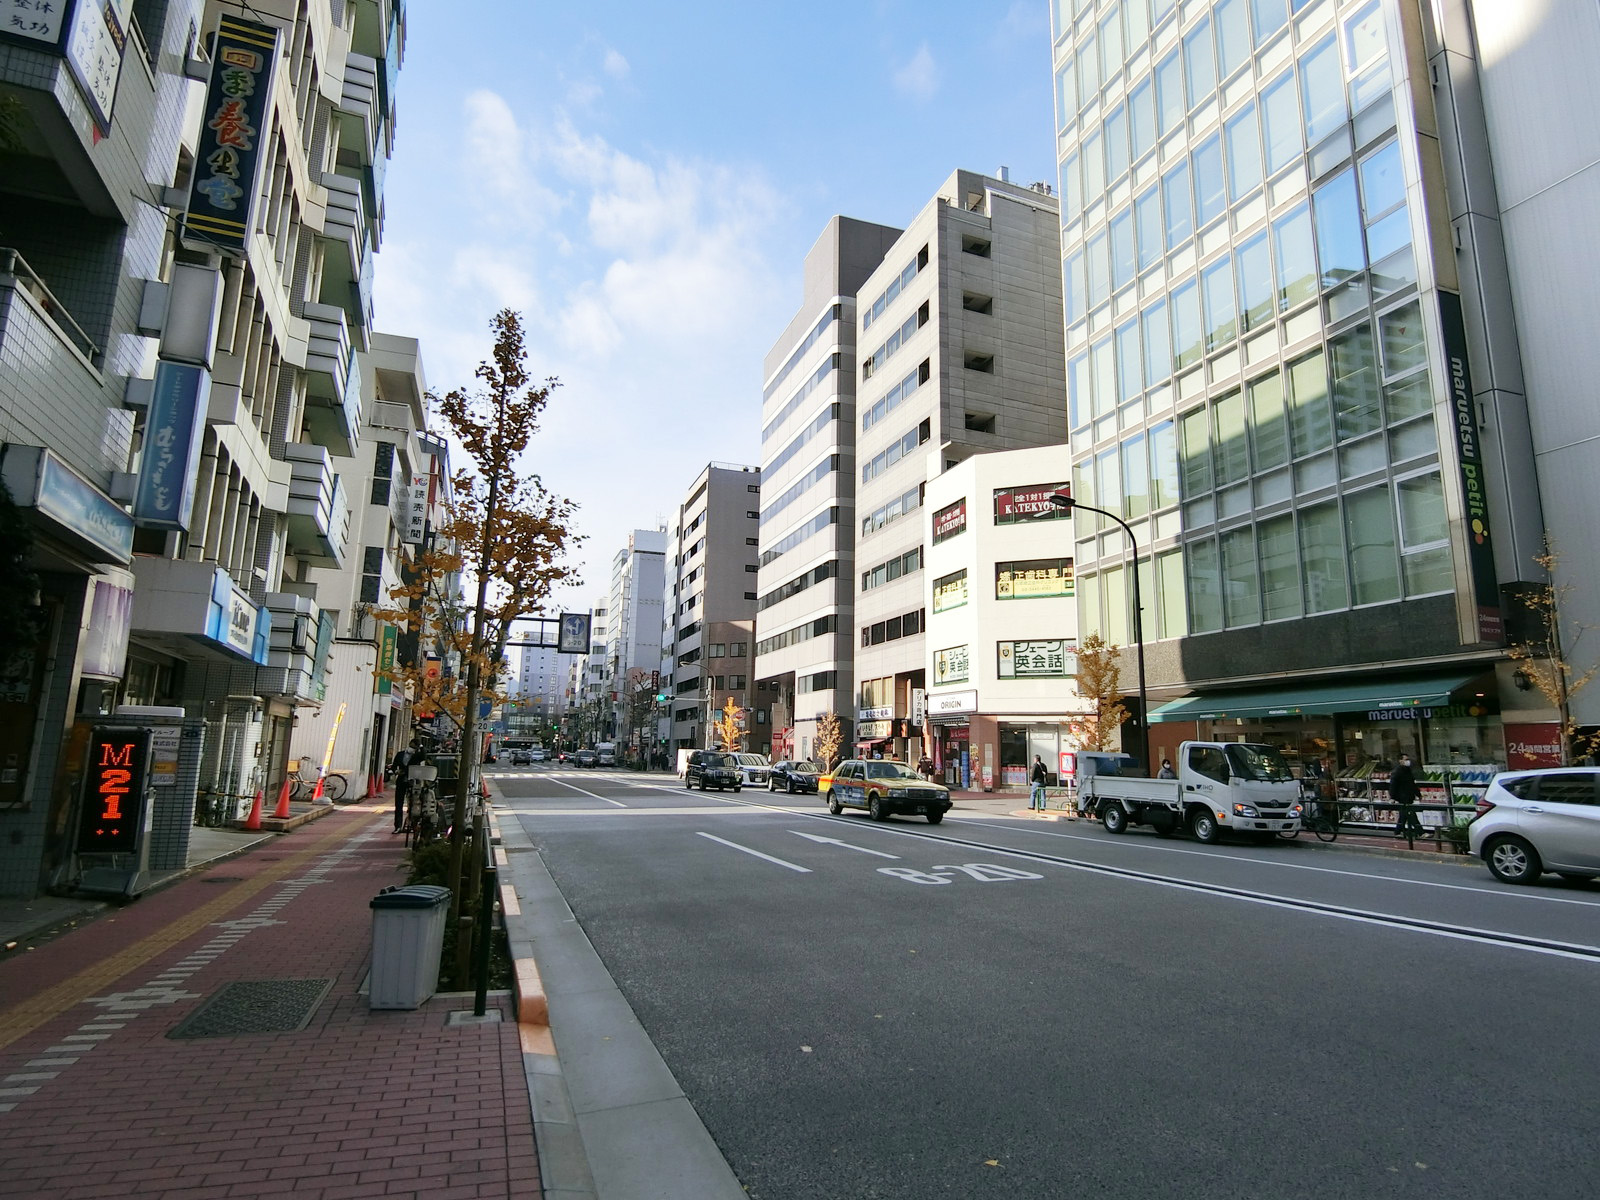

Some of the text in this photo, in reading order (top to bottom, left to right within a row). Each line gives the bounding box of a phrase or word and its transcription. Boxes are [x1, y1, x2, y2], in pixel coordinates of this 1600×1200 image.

[197, 46, 263, 210] 四季養生堂
[1451, 362, 1484, 516] maruetsu petit
[410, 489, 426, 539] 読売新聞
[1014, 654, 1063, 669] 英会話
[941, 700, 962, 709] ORIGIN
[876, 863, 1045, 885] 8-20
